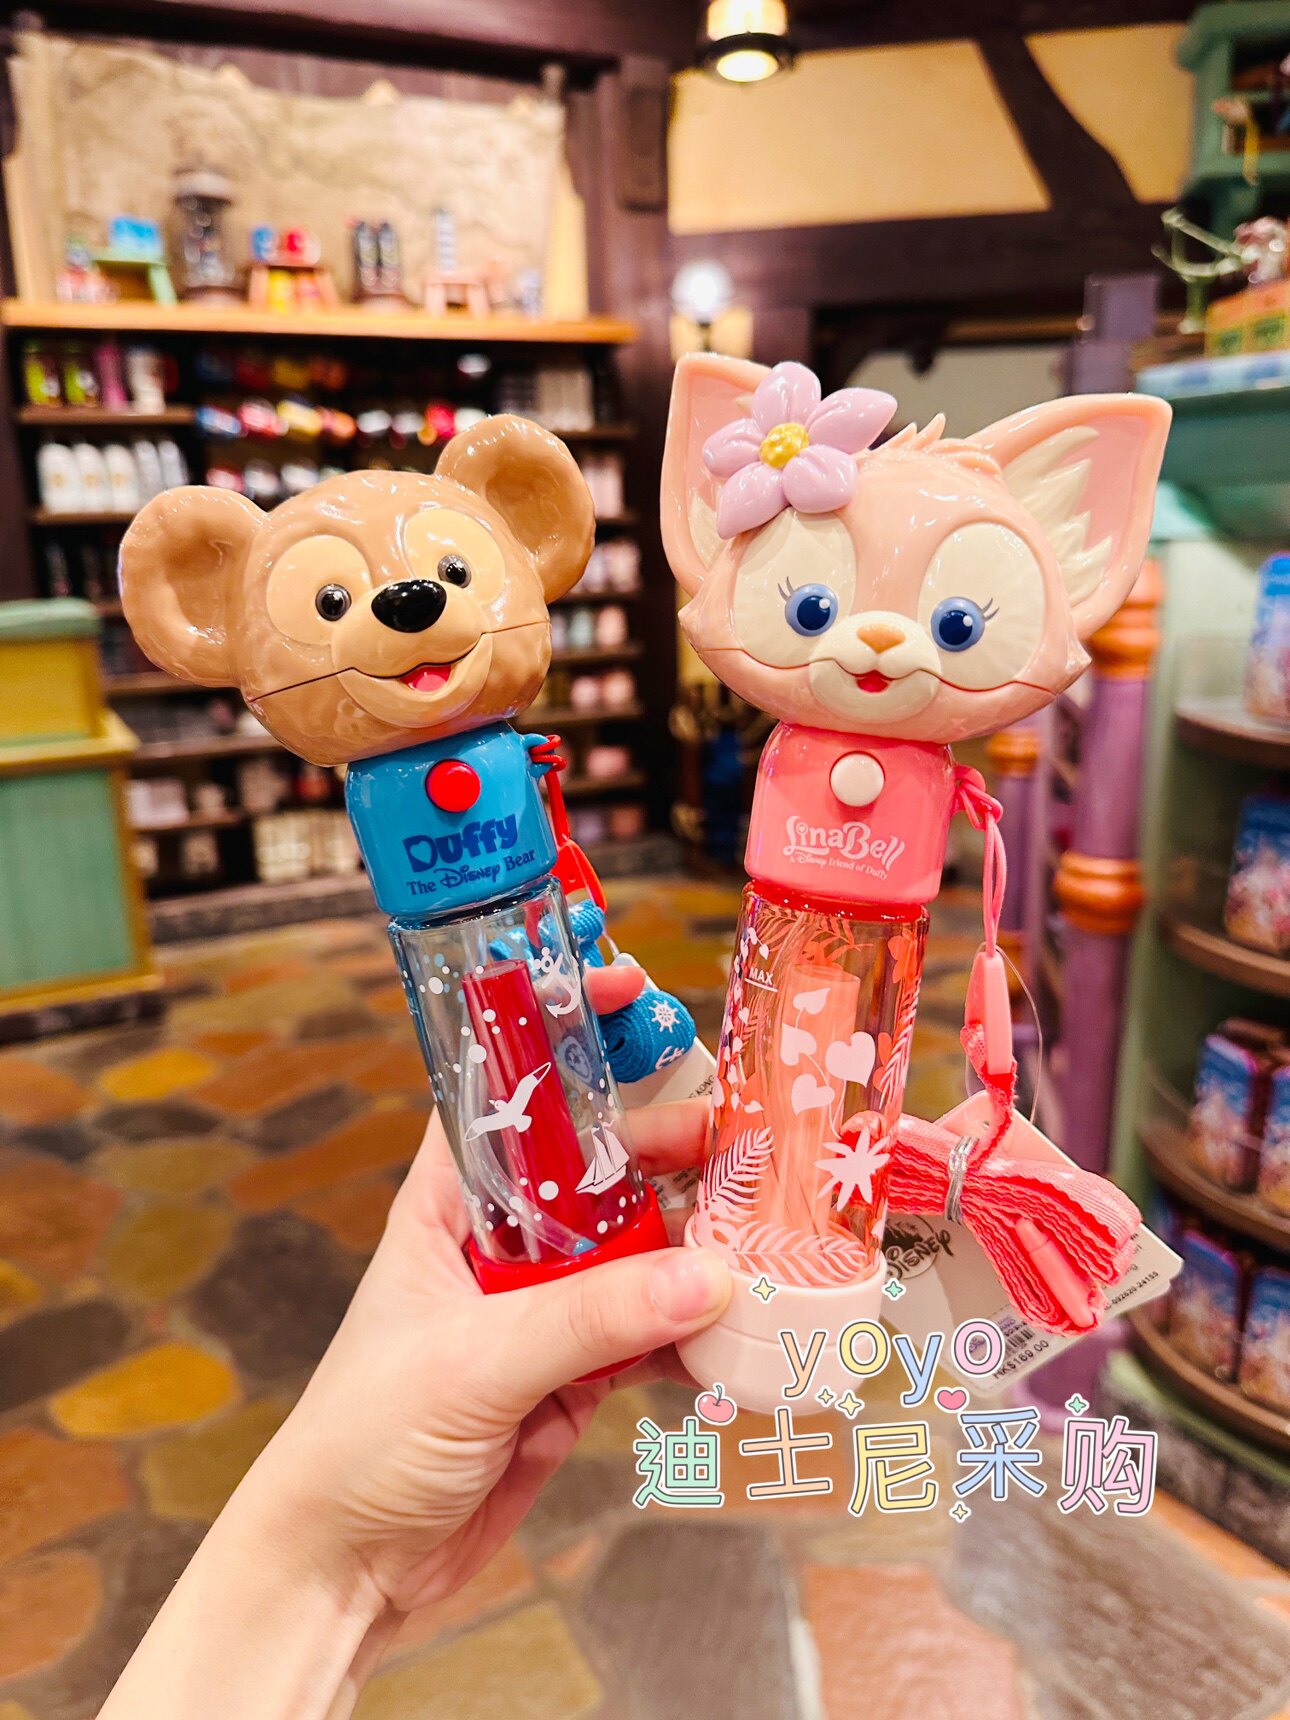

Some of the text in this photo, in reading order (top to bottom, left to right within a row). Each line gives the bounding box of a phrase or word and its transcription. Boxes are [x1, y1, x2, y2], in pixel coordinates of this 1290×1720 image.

[403, 813, 518, 873] Duffy
[783, 815, 905, 870] LinaBell
[406, 879, 437, 896] The
[503, 849, 536, 872] Bear
[865, 865, 888, 881] Duffy
[749, 967, 774, 985] MAX
